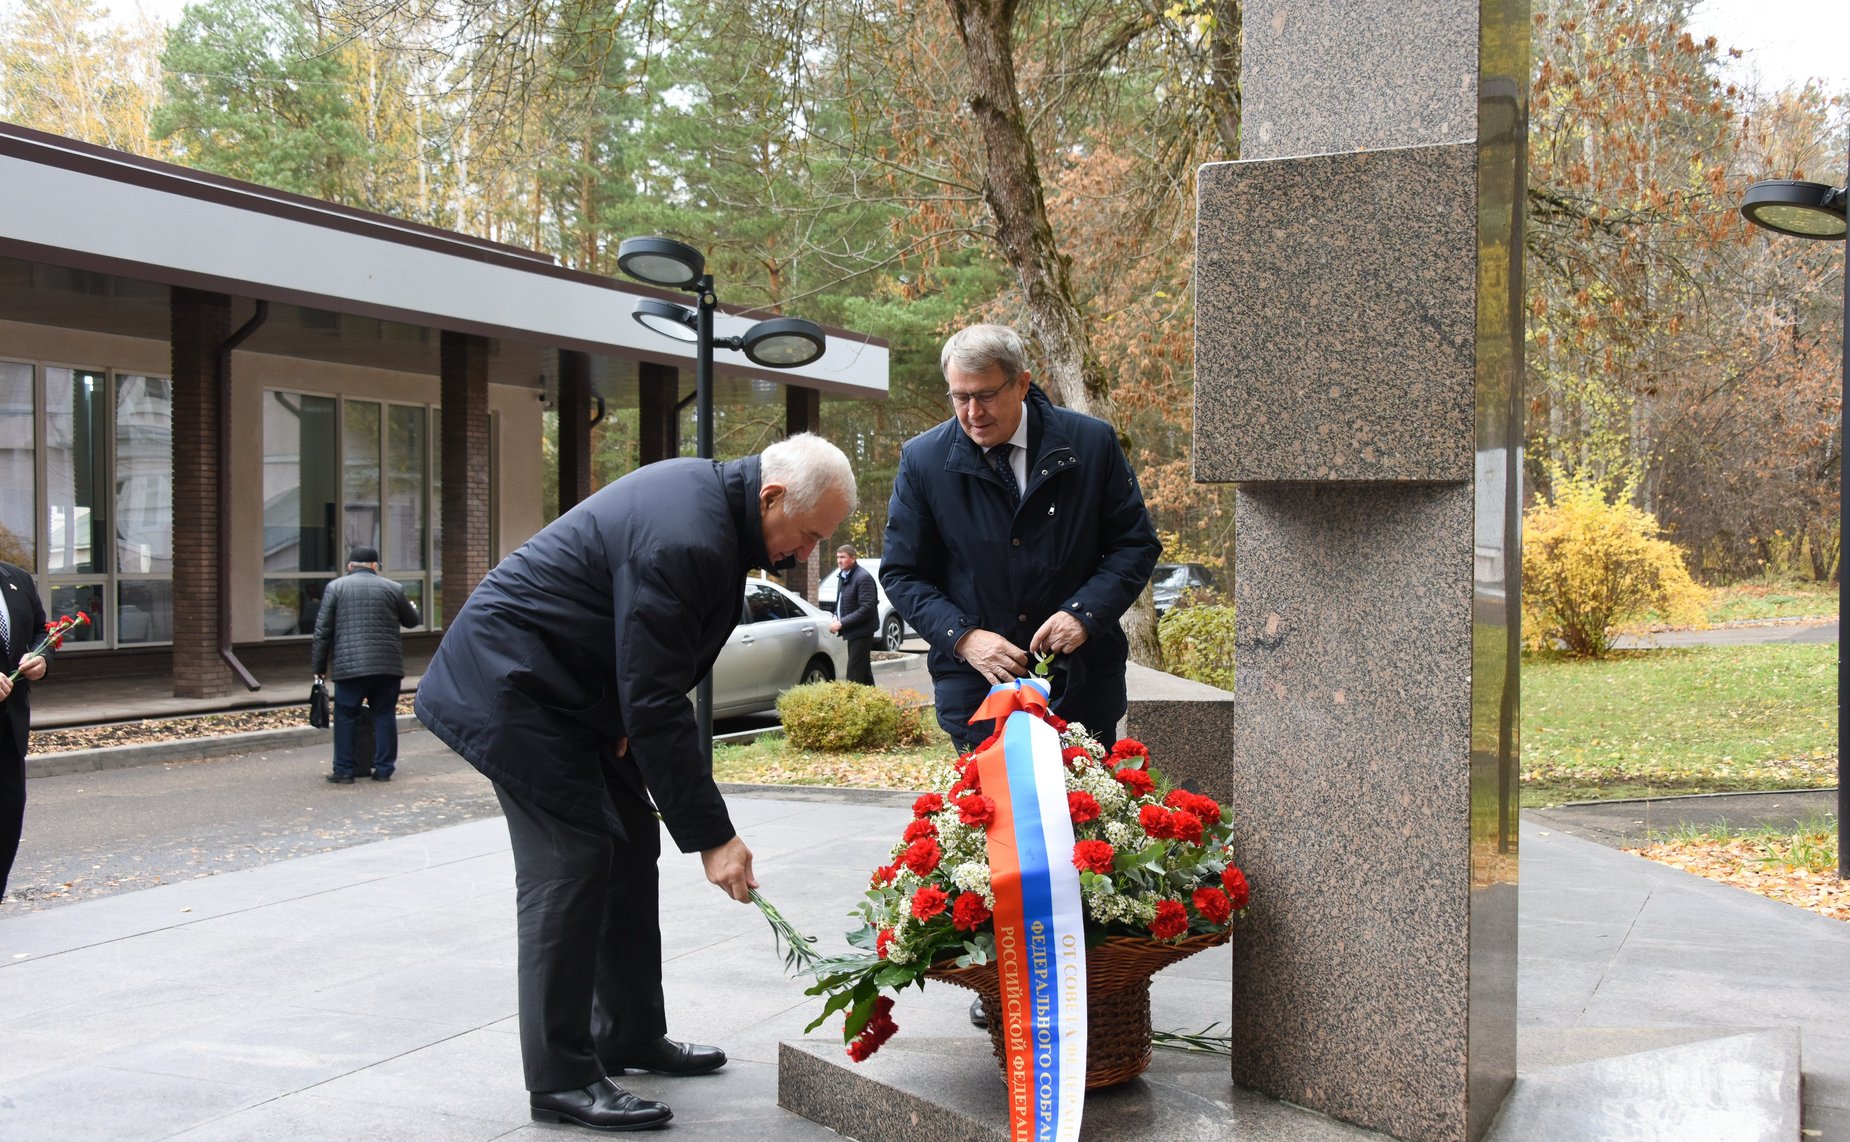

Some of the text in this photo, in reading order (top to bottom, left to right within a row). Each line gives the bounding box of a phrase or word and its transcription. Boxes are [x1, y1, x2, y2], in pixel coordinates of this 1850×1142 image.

[1000, 926, 1027, 1052] РОССИЙСКОЙ
[1030, 920, 1052, 1069] ФЕДЕРАЛЬНОГО
[1062, 934, 1077, 959] ОТ
[1063, 963, 1078, 1038] СОВЕТА
